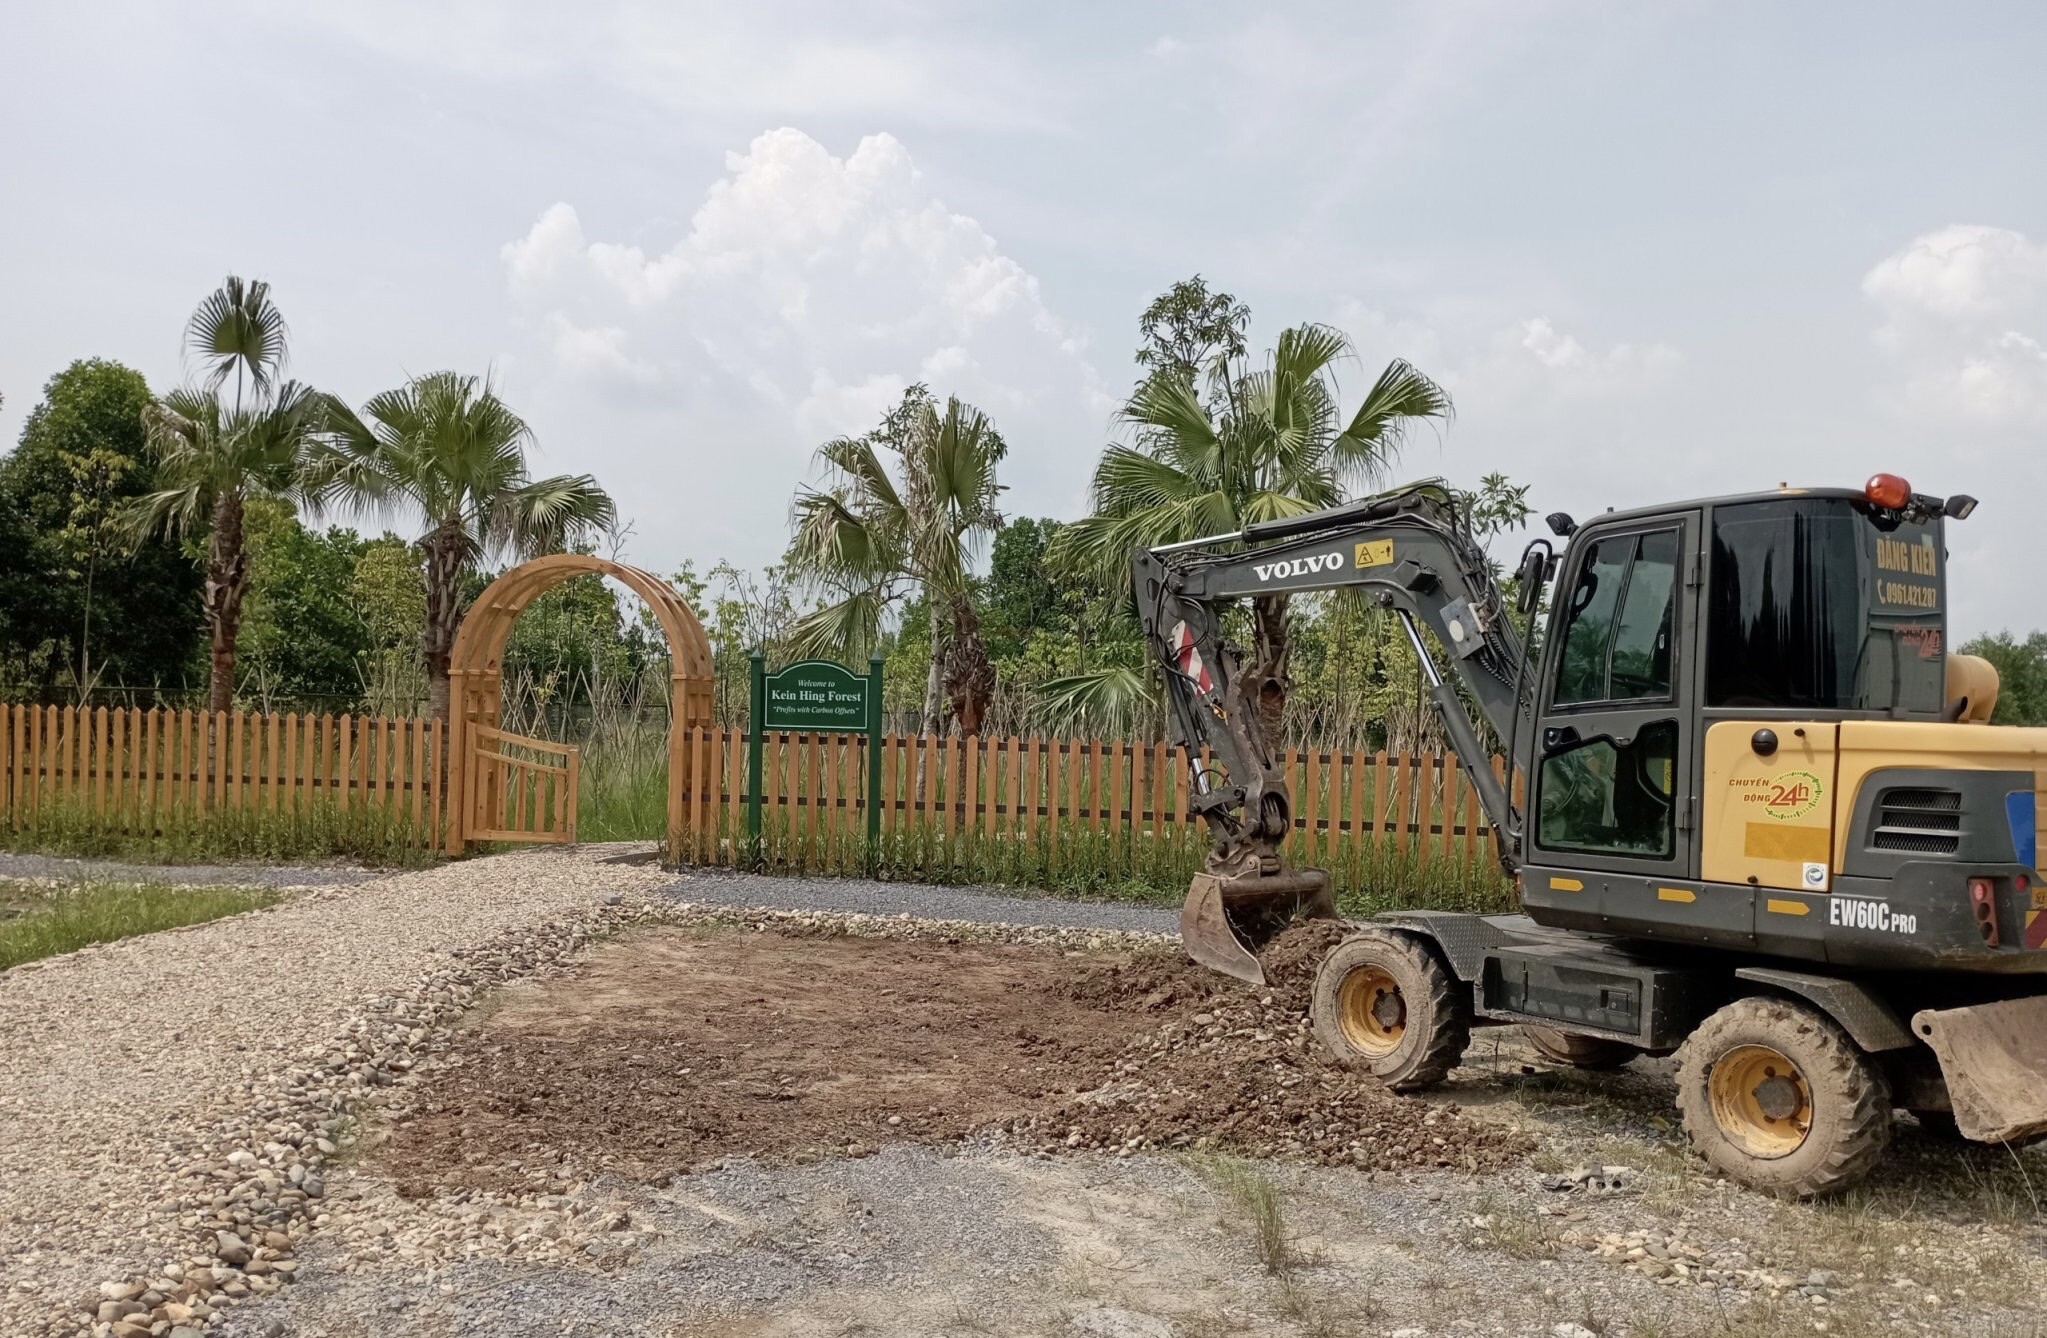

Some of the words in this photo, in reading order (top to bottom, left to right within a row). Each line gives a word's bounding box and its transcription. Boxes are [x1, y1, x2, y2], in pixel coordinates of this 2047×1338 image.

[1253, 552, 1344, 582] VOLVO
[798, 679, 827, 688] Welcome
[828, 680, 836, 688] to
[771, 689, 797, 701] Kein
[799, 690, 826, 704] Hing
[828, 691, 862, 703] Forest
[811, 706, 834, 714] Carbon
[1767, 782, 1809, 807] 24h
[1829, 897, 1890, 932] EW60C
[1890, 912, 1917, 935] PRO
